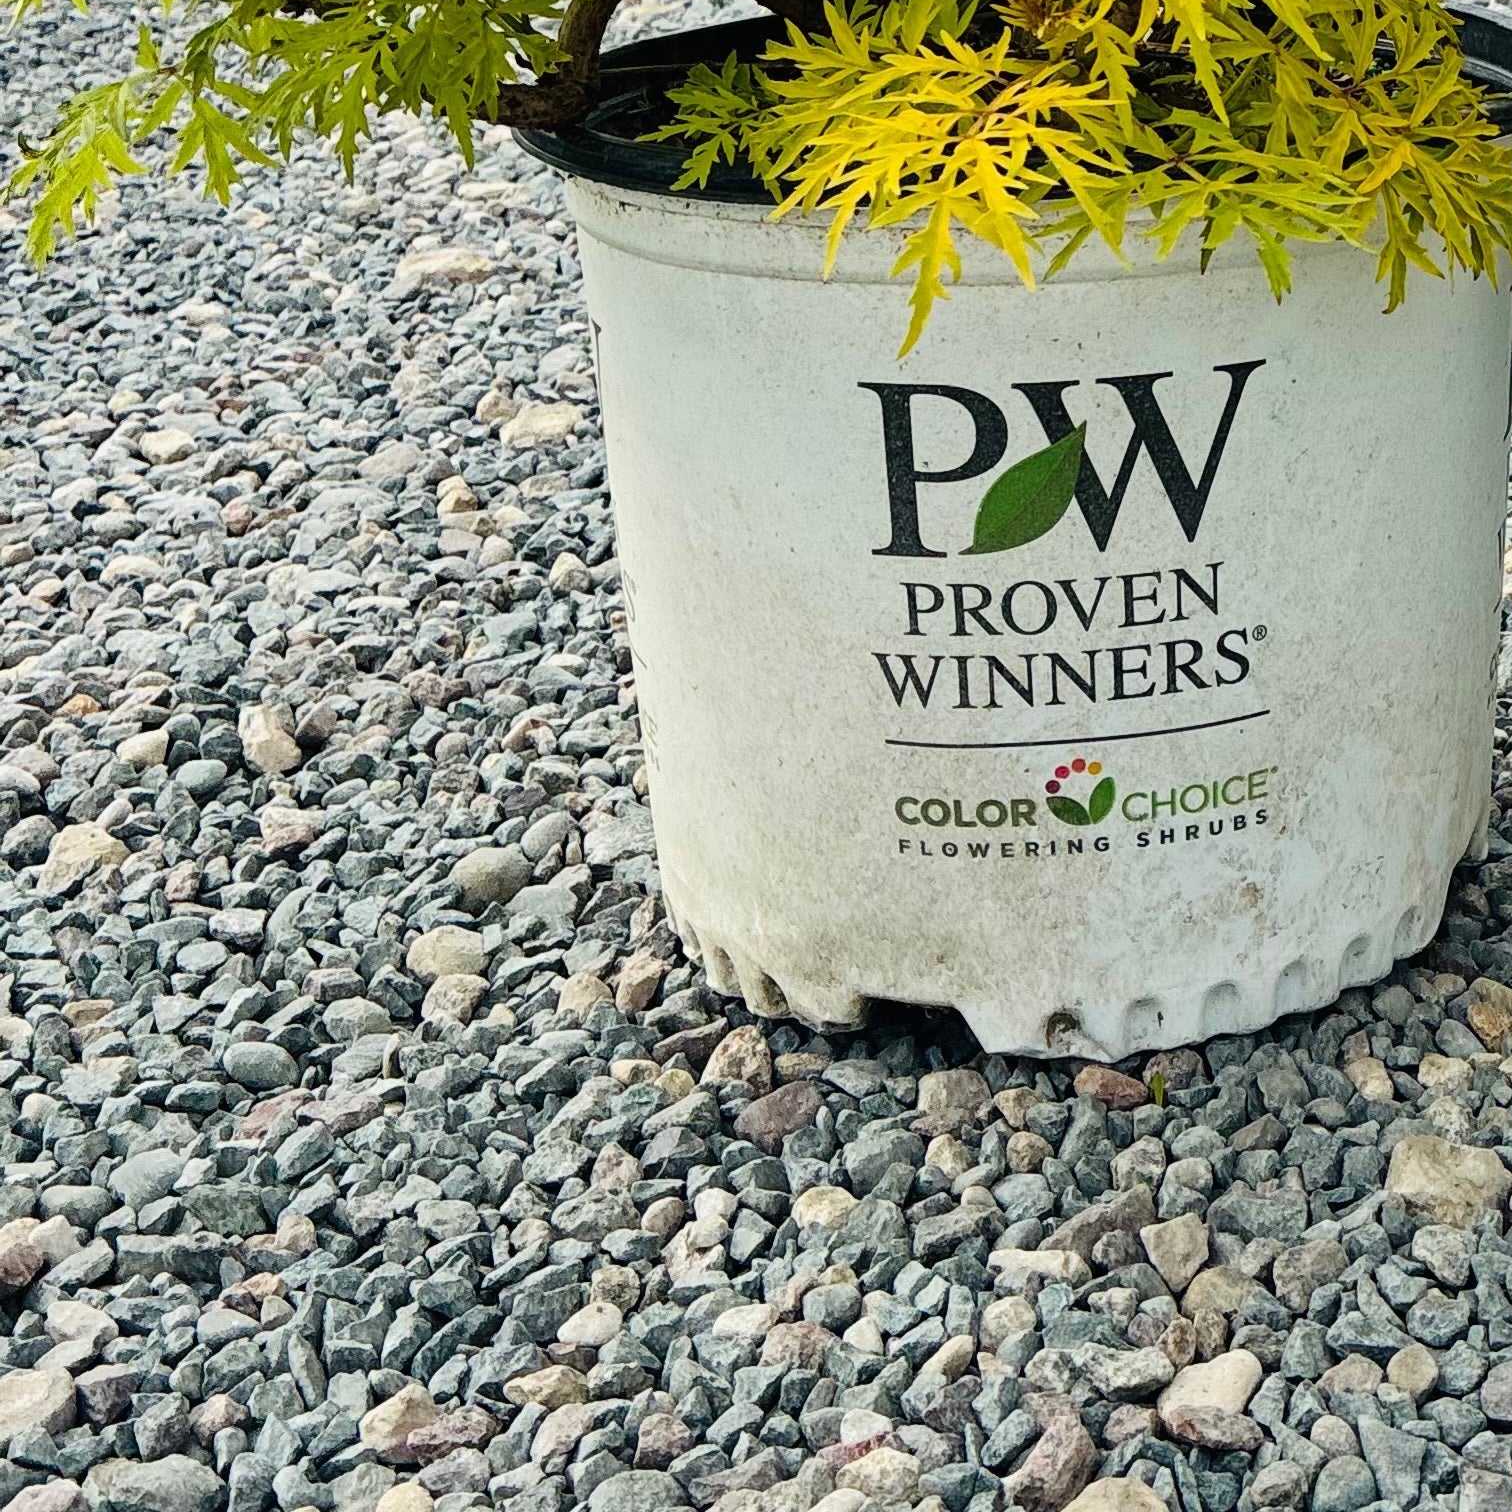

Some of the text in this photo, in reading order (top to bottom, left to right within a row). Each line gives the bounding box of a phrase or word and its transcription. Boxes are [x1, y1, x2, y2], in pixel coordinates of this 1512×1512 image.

[857, 358, 1267, 558] PW
[899, 561, 1225, 637] PROVEN
[894, 795, 1037, 829] COLOR
[898, 808, 1268, 859] FLOWERING SHRUBS
